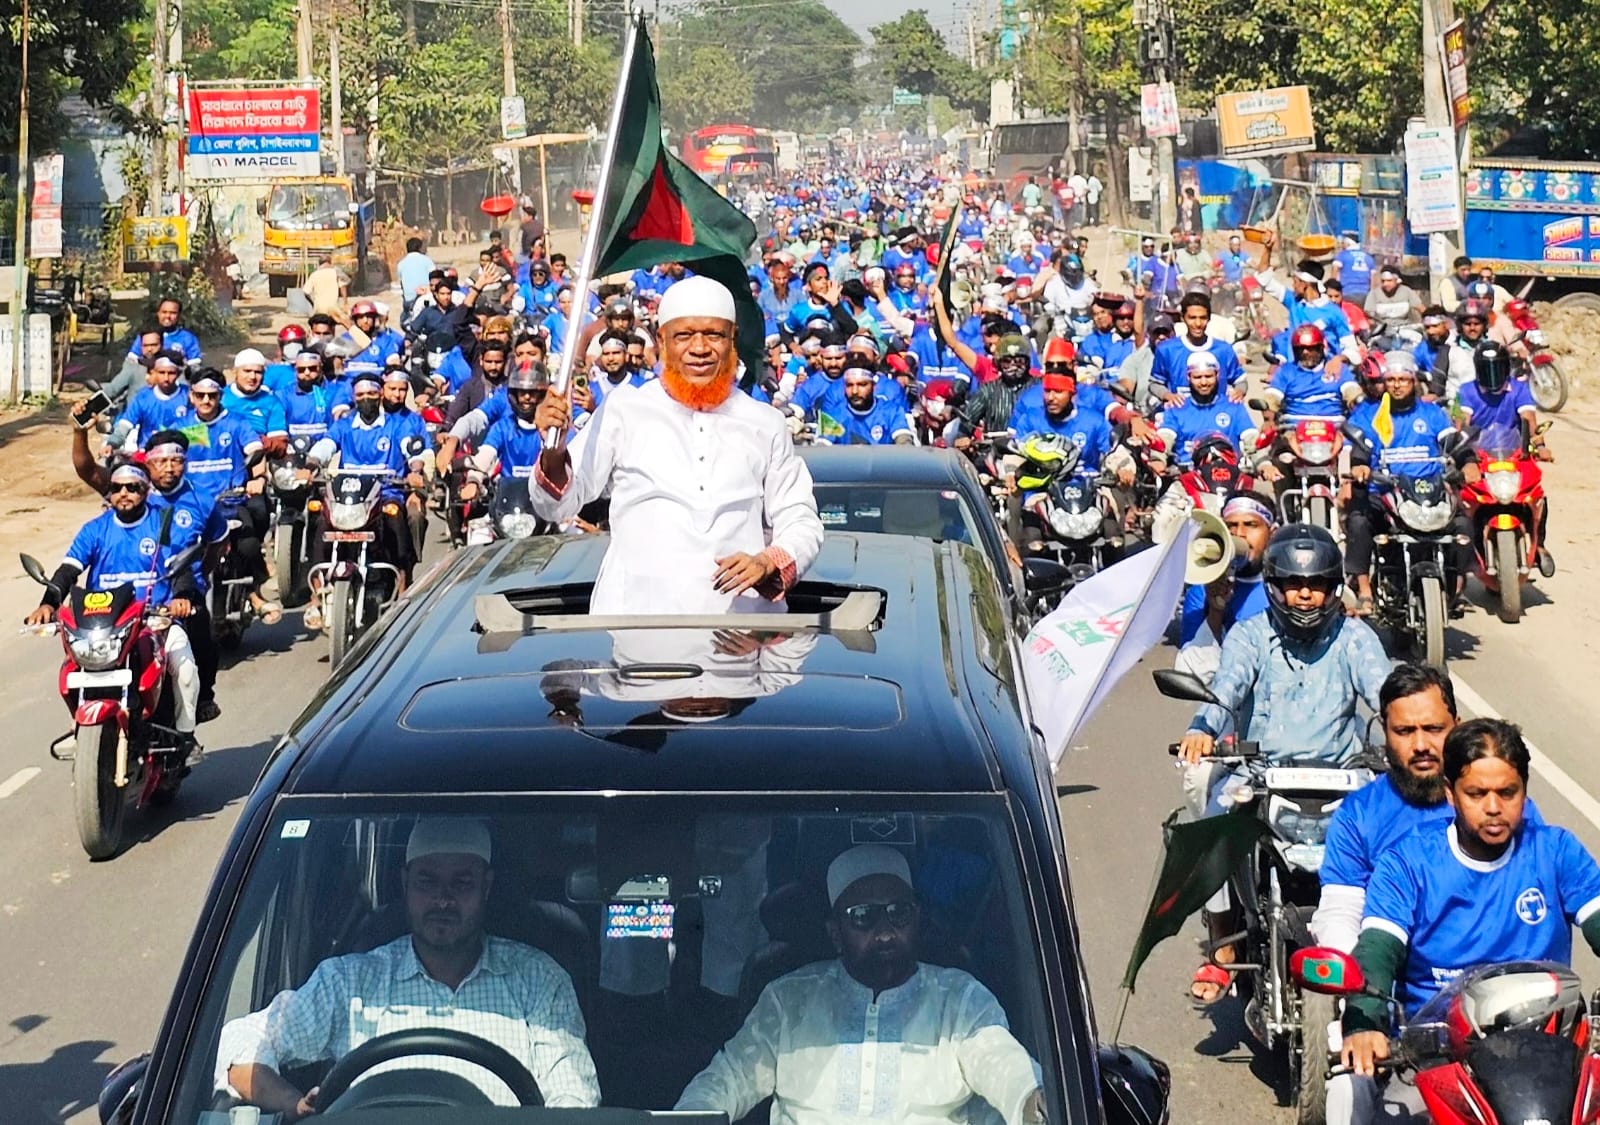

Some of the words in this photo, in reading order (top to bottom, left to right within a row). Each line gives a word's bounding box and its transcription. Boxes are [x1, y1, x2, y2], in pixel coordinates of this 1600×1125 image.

[201, 98, 243, 112] সাবধানে
[245, 99, 282, 112] চালাবো
[284, 95, 307, 112] গাড়ি
[202, 113, 245, 129] নিরাপদে
[245, 113, 282, 128] ফিরবো
[284, 111, 307, 129] বাড়ি
[213, 139, 233, 150] জেলা
[234, 156, 297, 167] MARCEL
